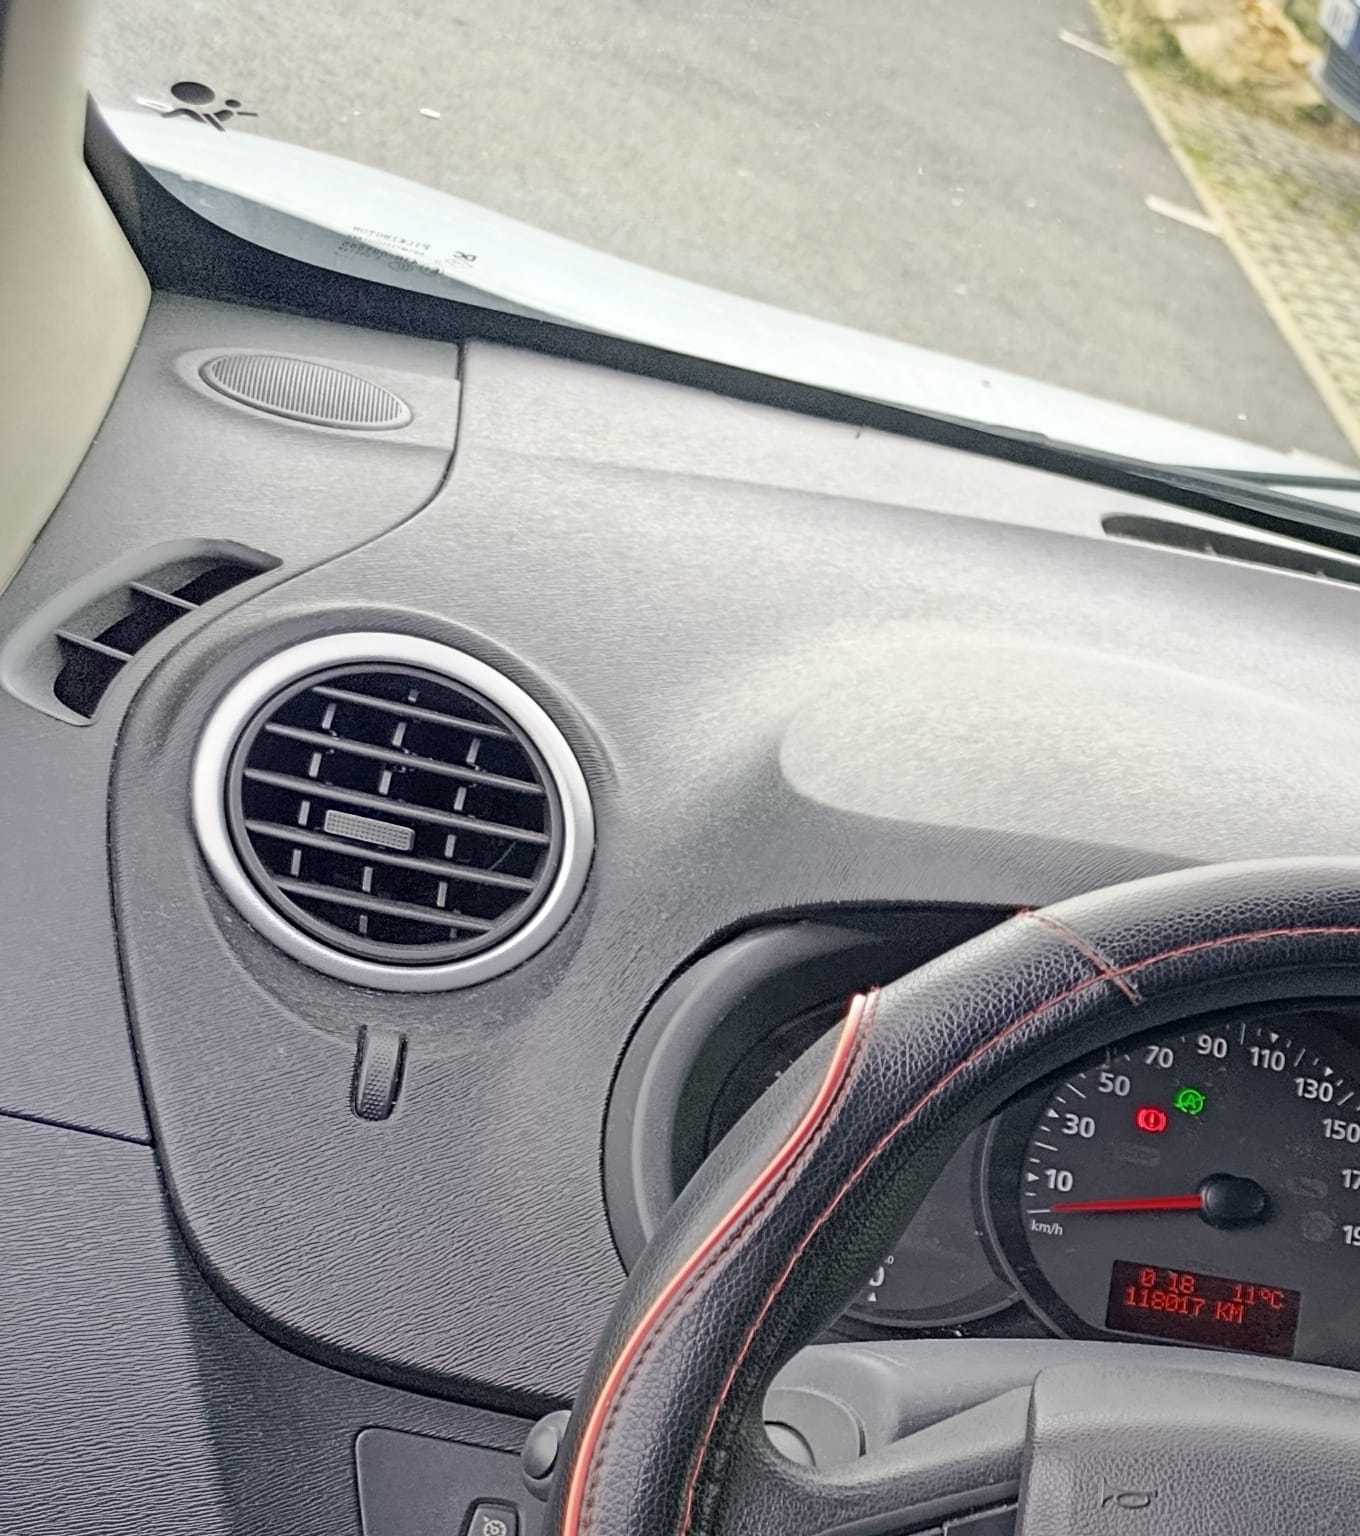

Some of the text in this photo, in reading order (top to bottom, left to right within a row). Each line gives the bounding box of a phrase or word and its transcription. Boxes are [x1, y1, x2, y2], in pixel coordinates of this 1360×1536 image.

[1144, 1045, 1174, 1069] 70
[1197, 1035, 1228, 1059] 90
[1249, 1046, 1286, 1072] 110
[1098, 1073, 1131, 1096] 50
[1294, 1077, 1334, 1103] 130
[1063, 1113, 1096, 1139] 30
[1045, 1168, 1073, 1192] 10
[1031, 1220, 1064, 1237] km/h
[1215, 1301, 1246, 1324] KM
